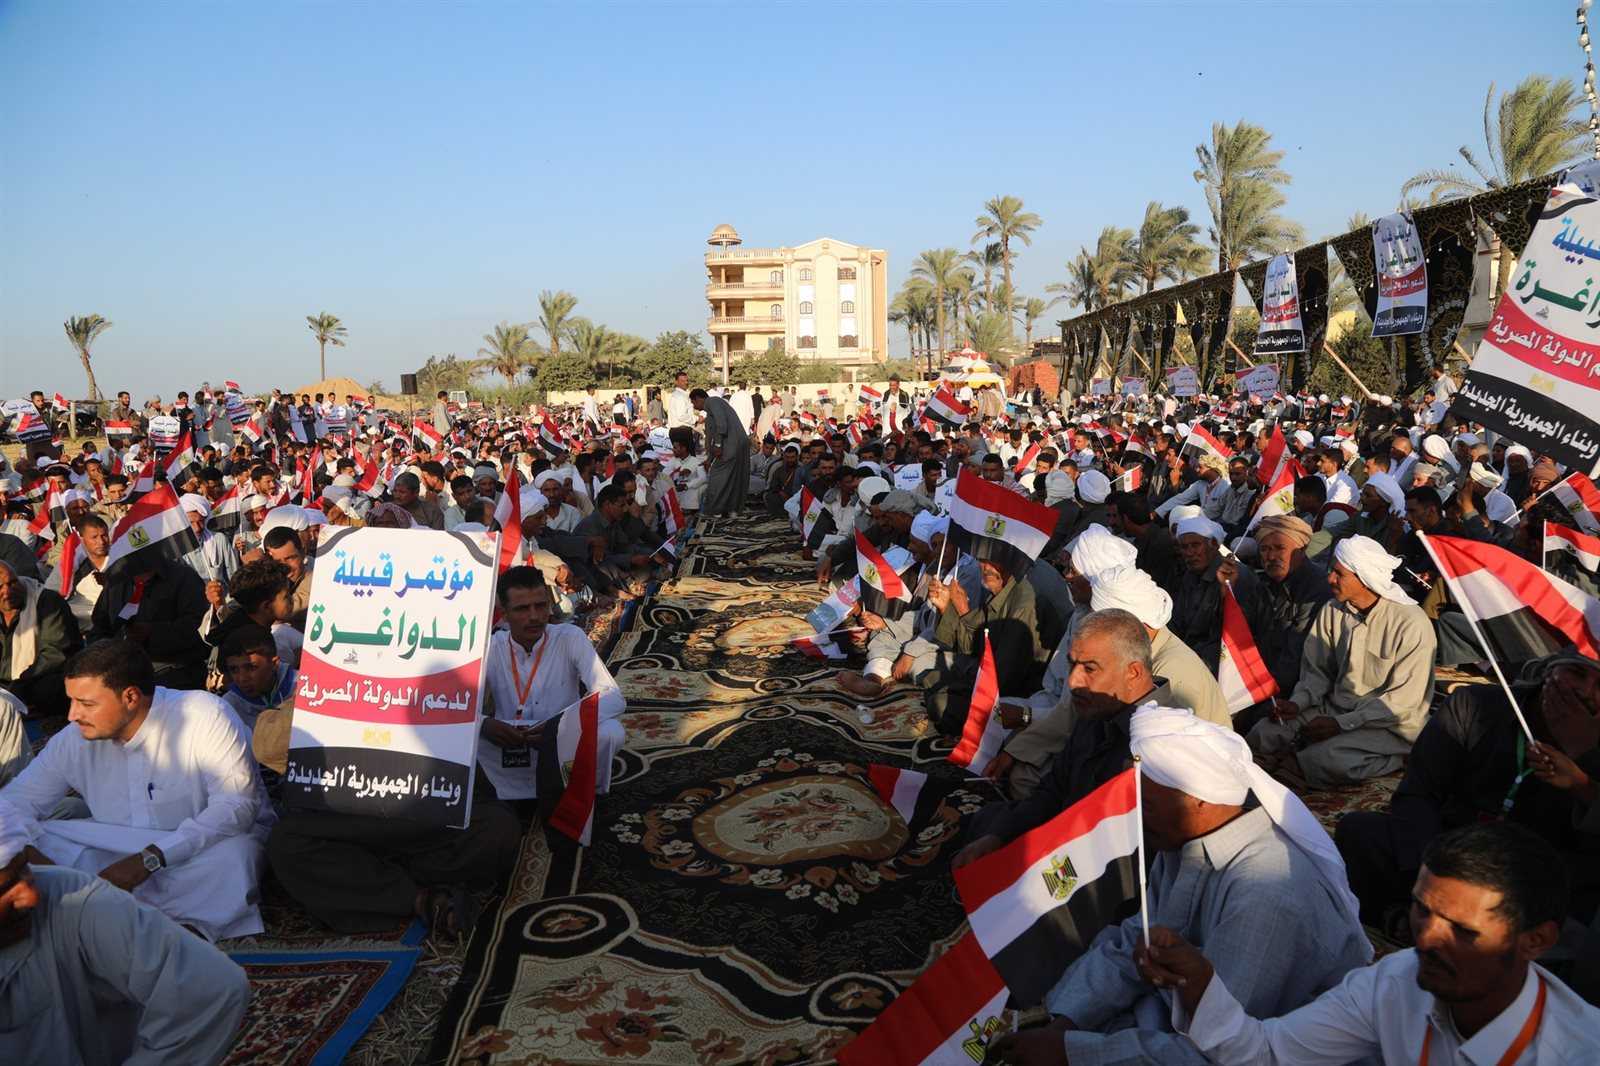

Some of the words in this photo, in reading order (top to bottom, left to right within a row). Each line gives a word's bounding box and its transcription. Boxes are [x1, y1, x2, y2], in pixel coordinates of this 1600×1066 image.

[1552, 217, 1600, 265] بيلة
[1491, 315, 1543, 350] المصرية
[1540, 334, 1594, 369] الدولة
[1460, 379, 1507, 412] الجديدة
[1504, 397, 1566, 439] الجمهورية
[1560, 430, 1599, 460] وبناء
[902, 470, 920, 482] قبيلة
[333, 550, 394, 598] قبيلة
[394, 555, 474, 601] مؤتمر
[309, 603, 477, 660] الدواغرة
[299, 674, 360, 707] المصرية
[362, 679, 420, 711] الدولة
[421, 689, 472, 715] لدعم
[287, 761, 346, 793] الجديدة
[347, 764, 420, 800] الجمهورية
[421, 775, 462, 807] وبناء
